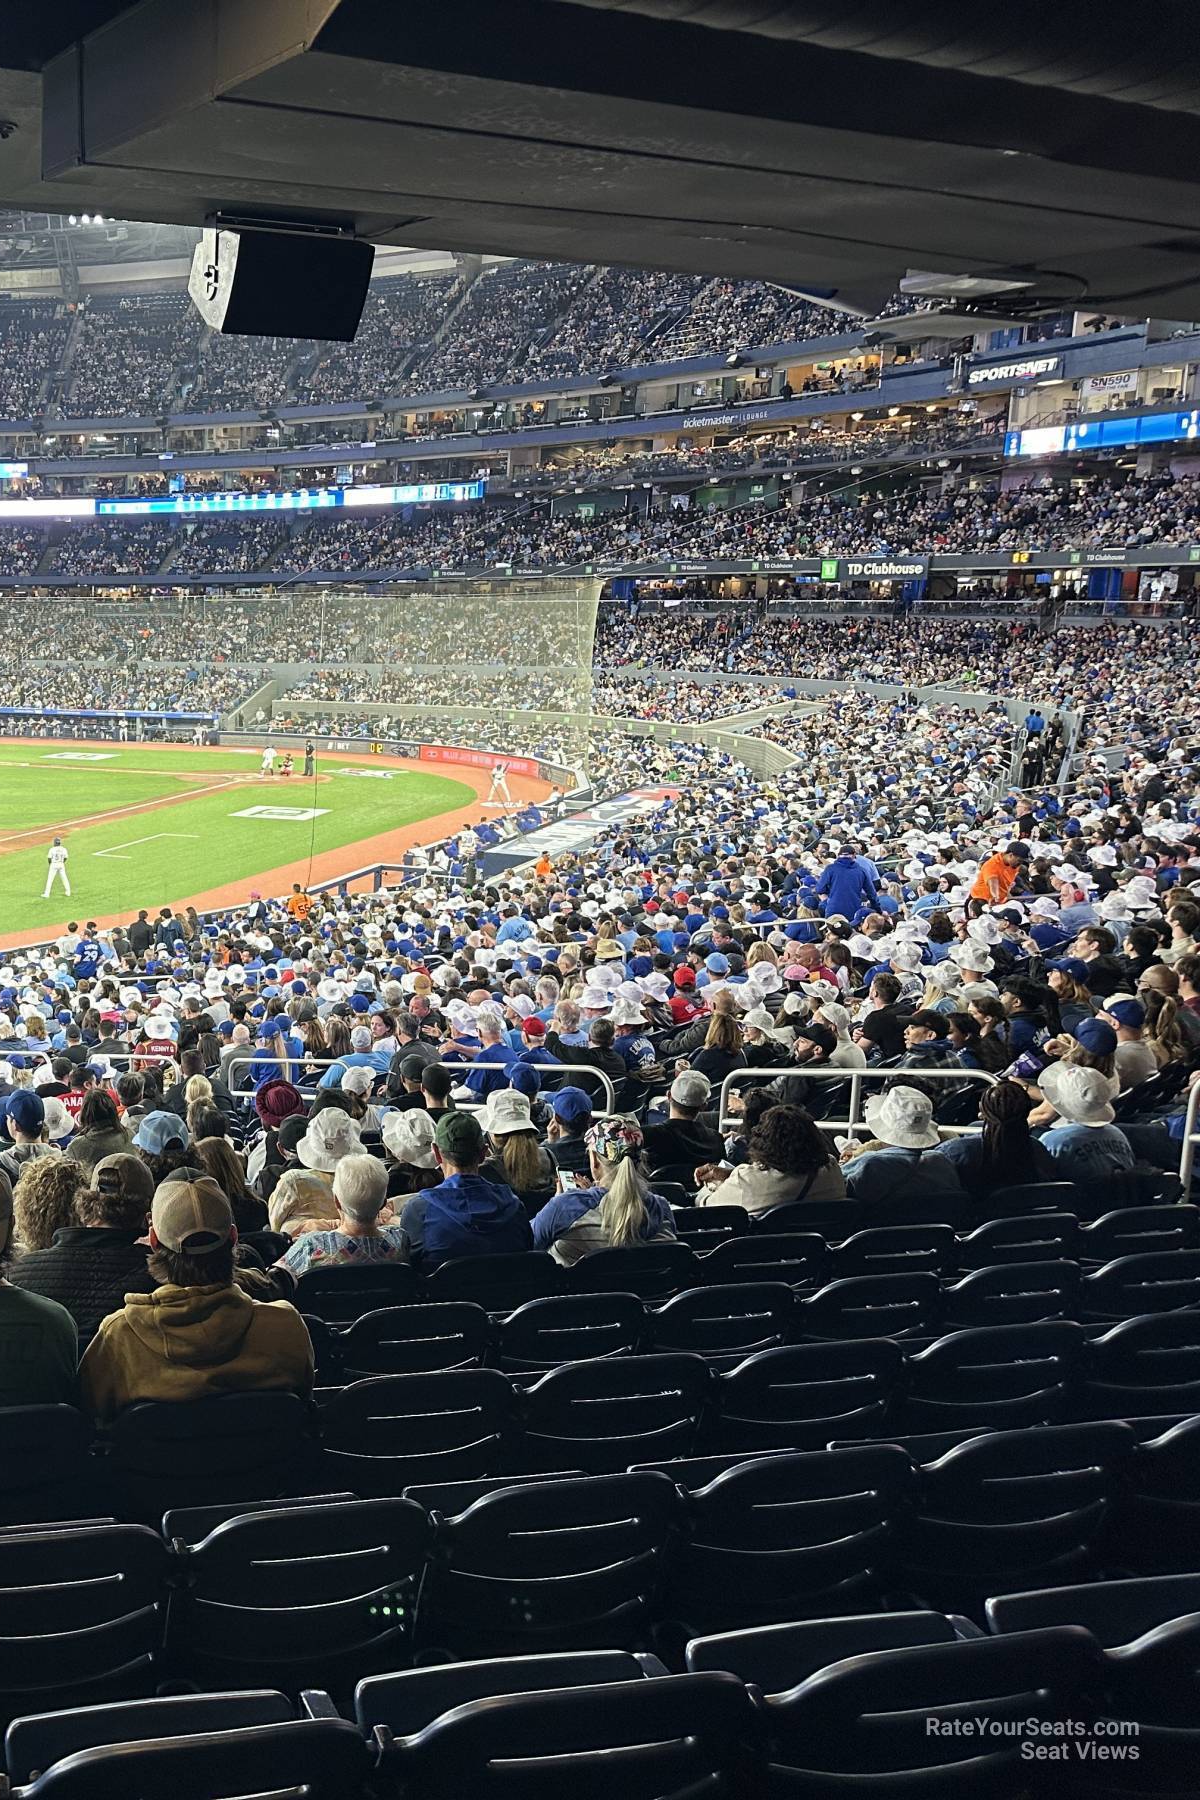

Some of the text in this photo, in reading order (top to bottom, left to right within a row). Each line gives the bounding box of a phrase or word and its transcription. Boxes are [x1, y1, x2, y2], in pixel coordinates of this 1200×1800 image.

[968, 357, 1059, 384] SPORTSNET
[1090, 374, 1131, 388] SN590
[742, 410, 768, 421] LOUNGE
[848, 563, 863, 575] TD
[864, 562, 923, 575] Clubhouse
[82, 950, 99, 962] 29
[150, 1045, 170, 1053] KENNY
